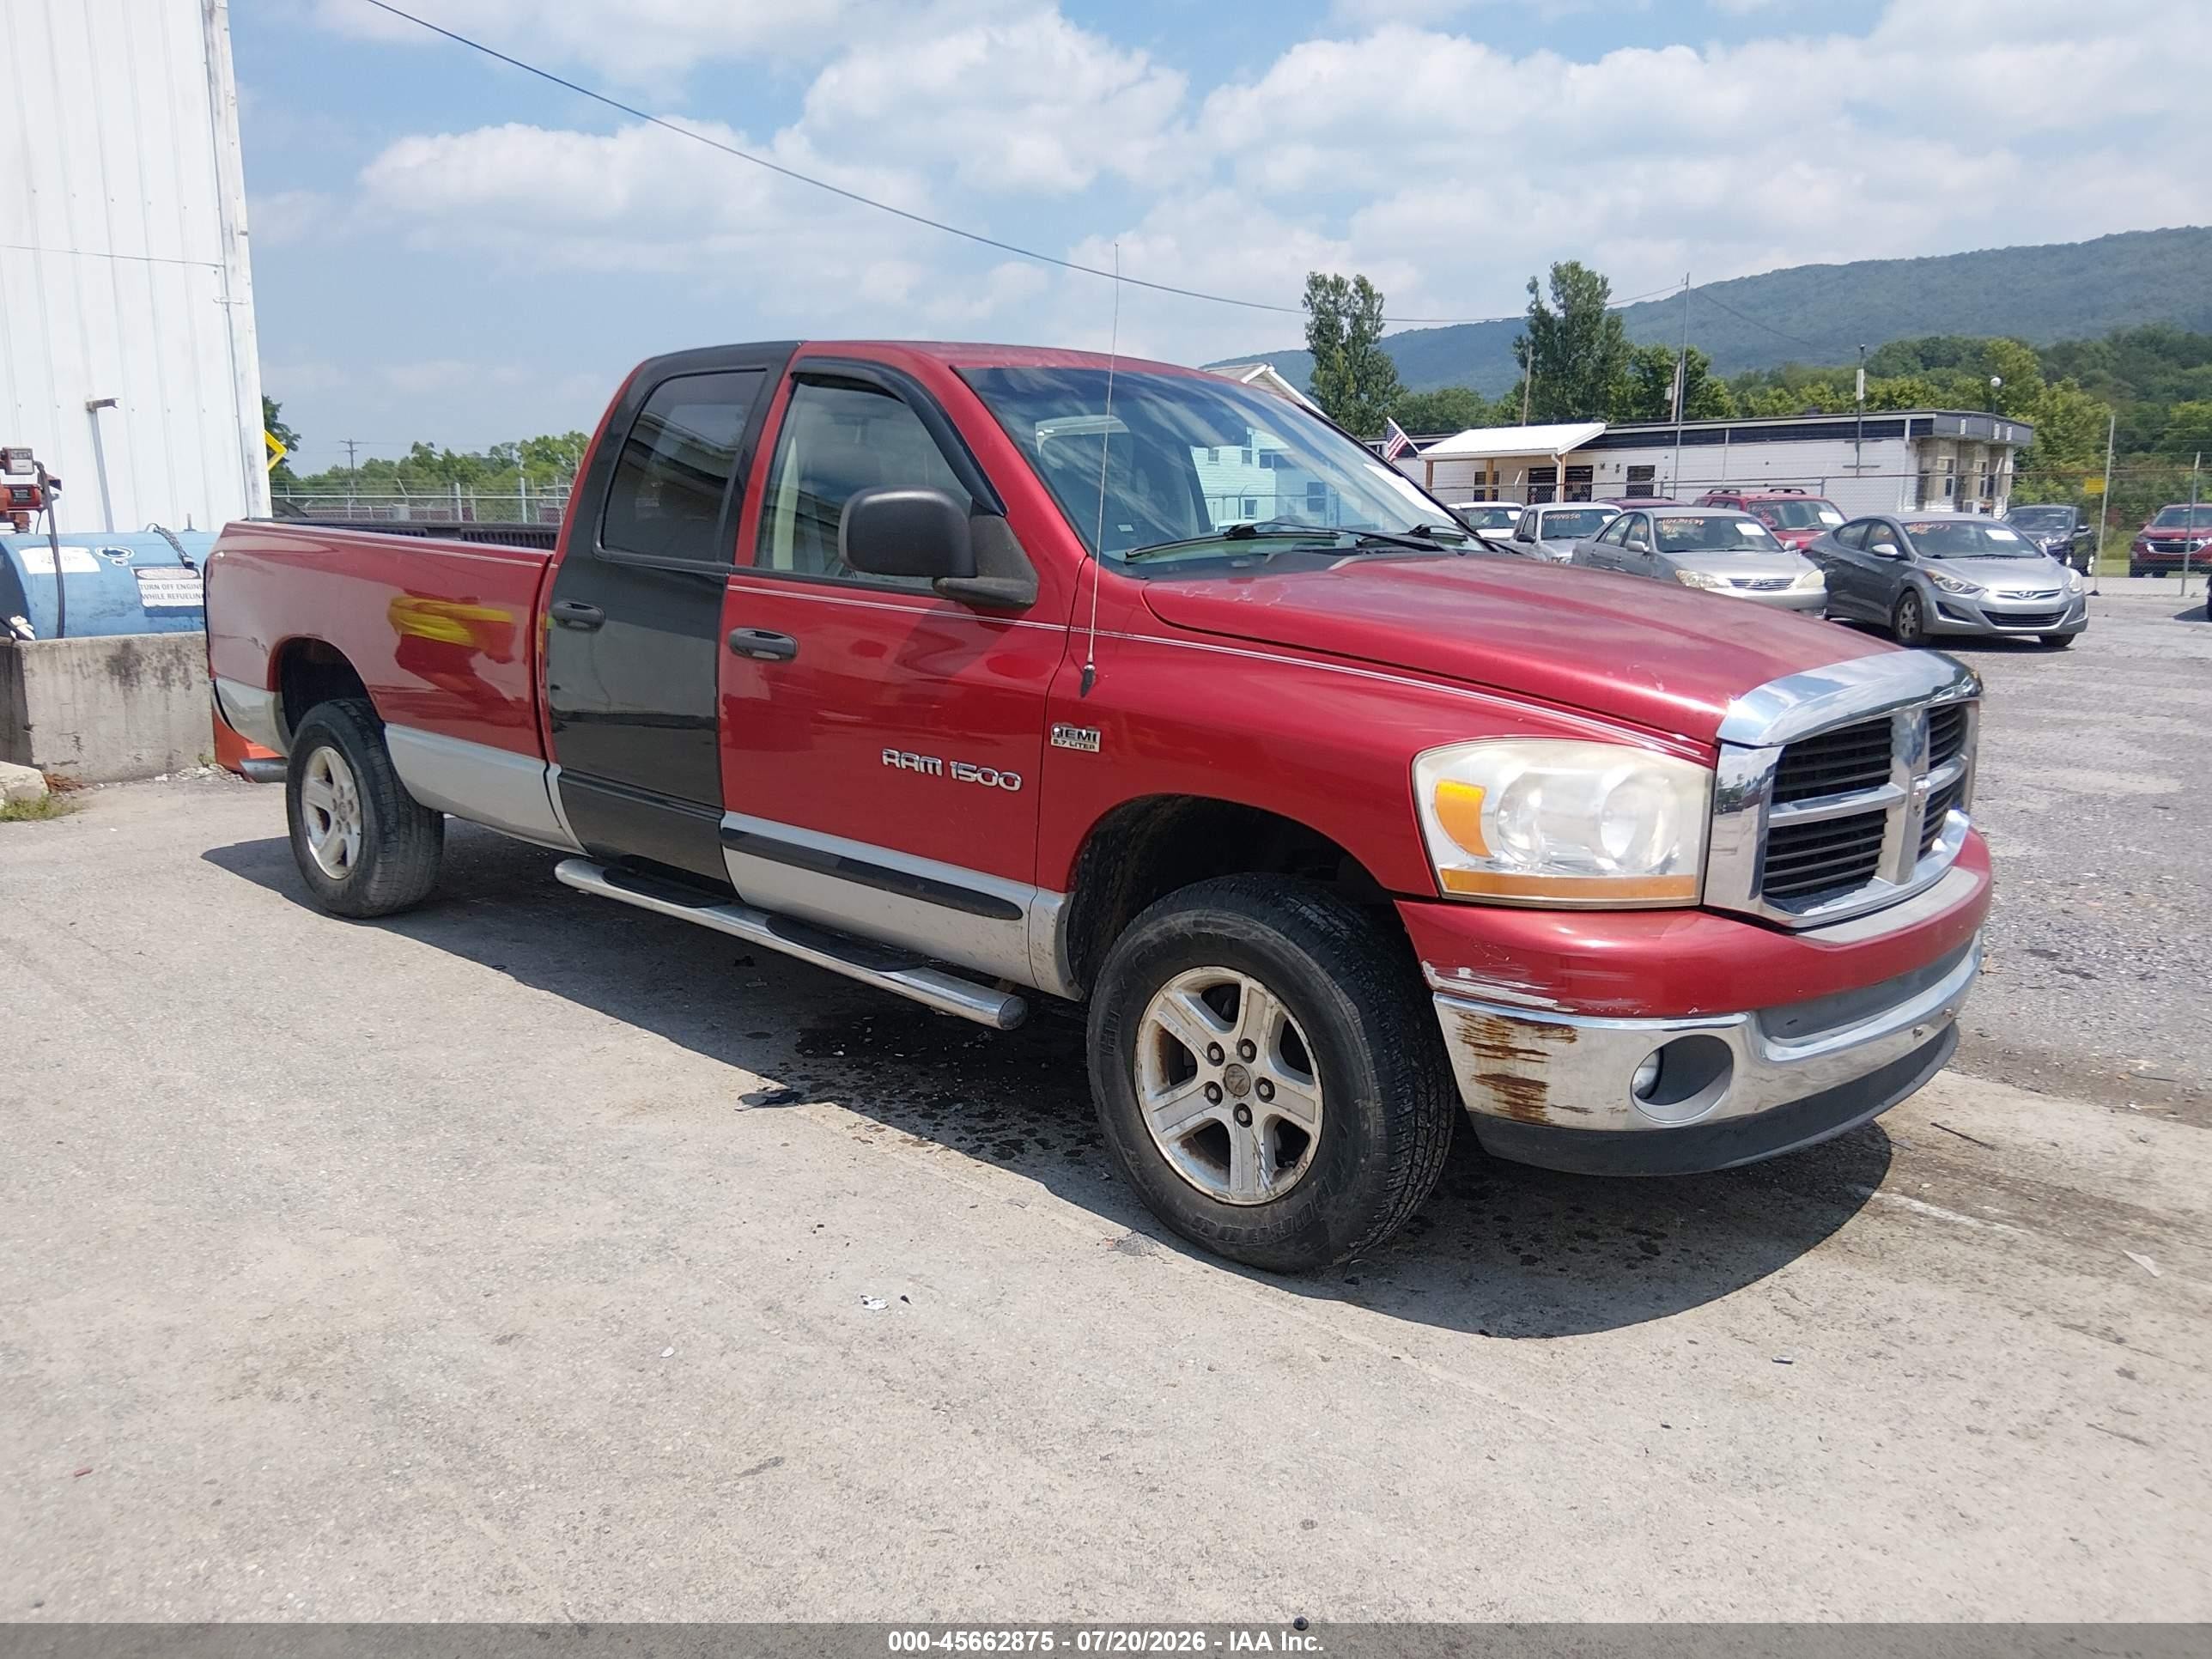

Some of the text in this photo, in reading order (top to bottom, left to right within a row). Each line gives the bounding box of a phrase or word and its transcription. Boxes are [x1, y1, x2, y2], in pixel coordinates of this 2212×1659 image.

[1069, 740, 1095, 750] LITER
[882, 749, 1022, 791] RAM 1500
